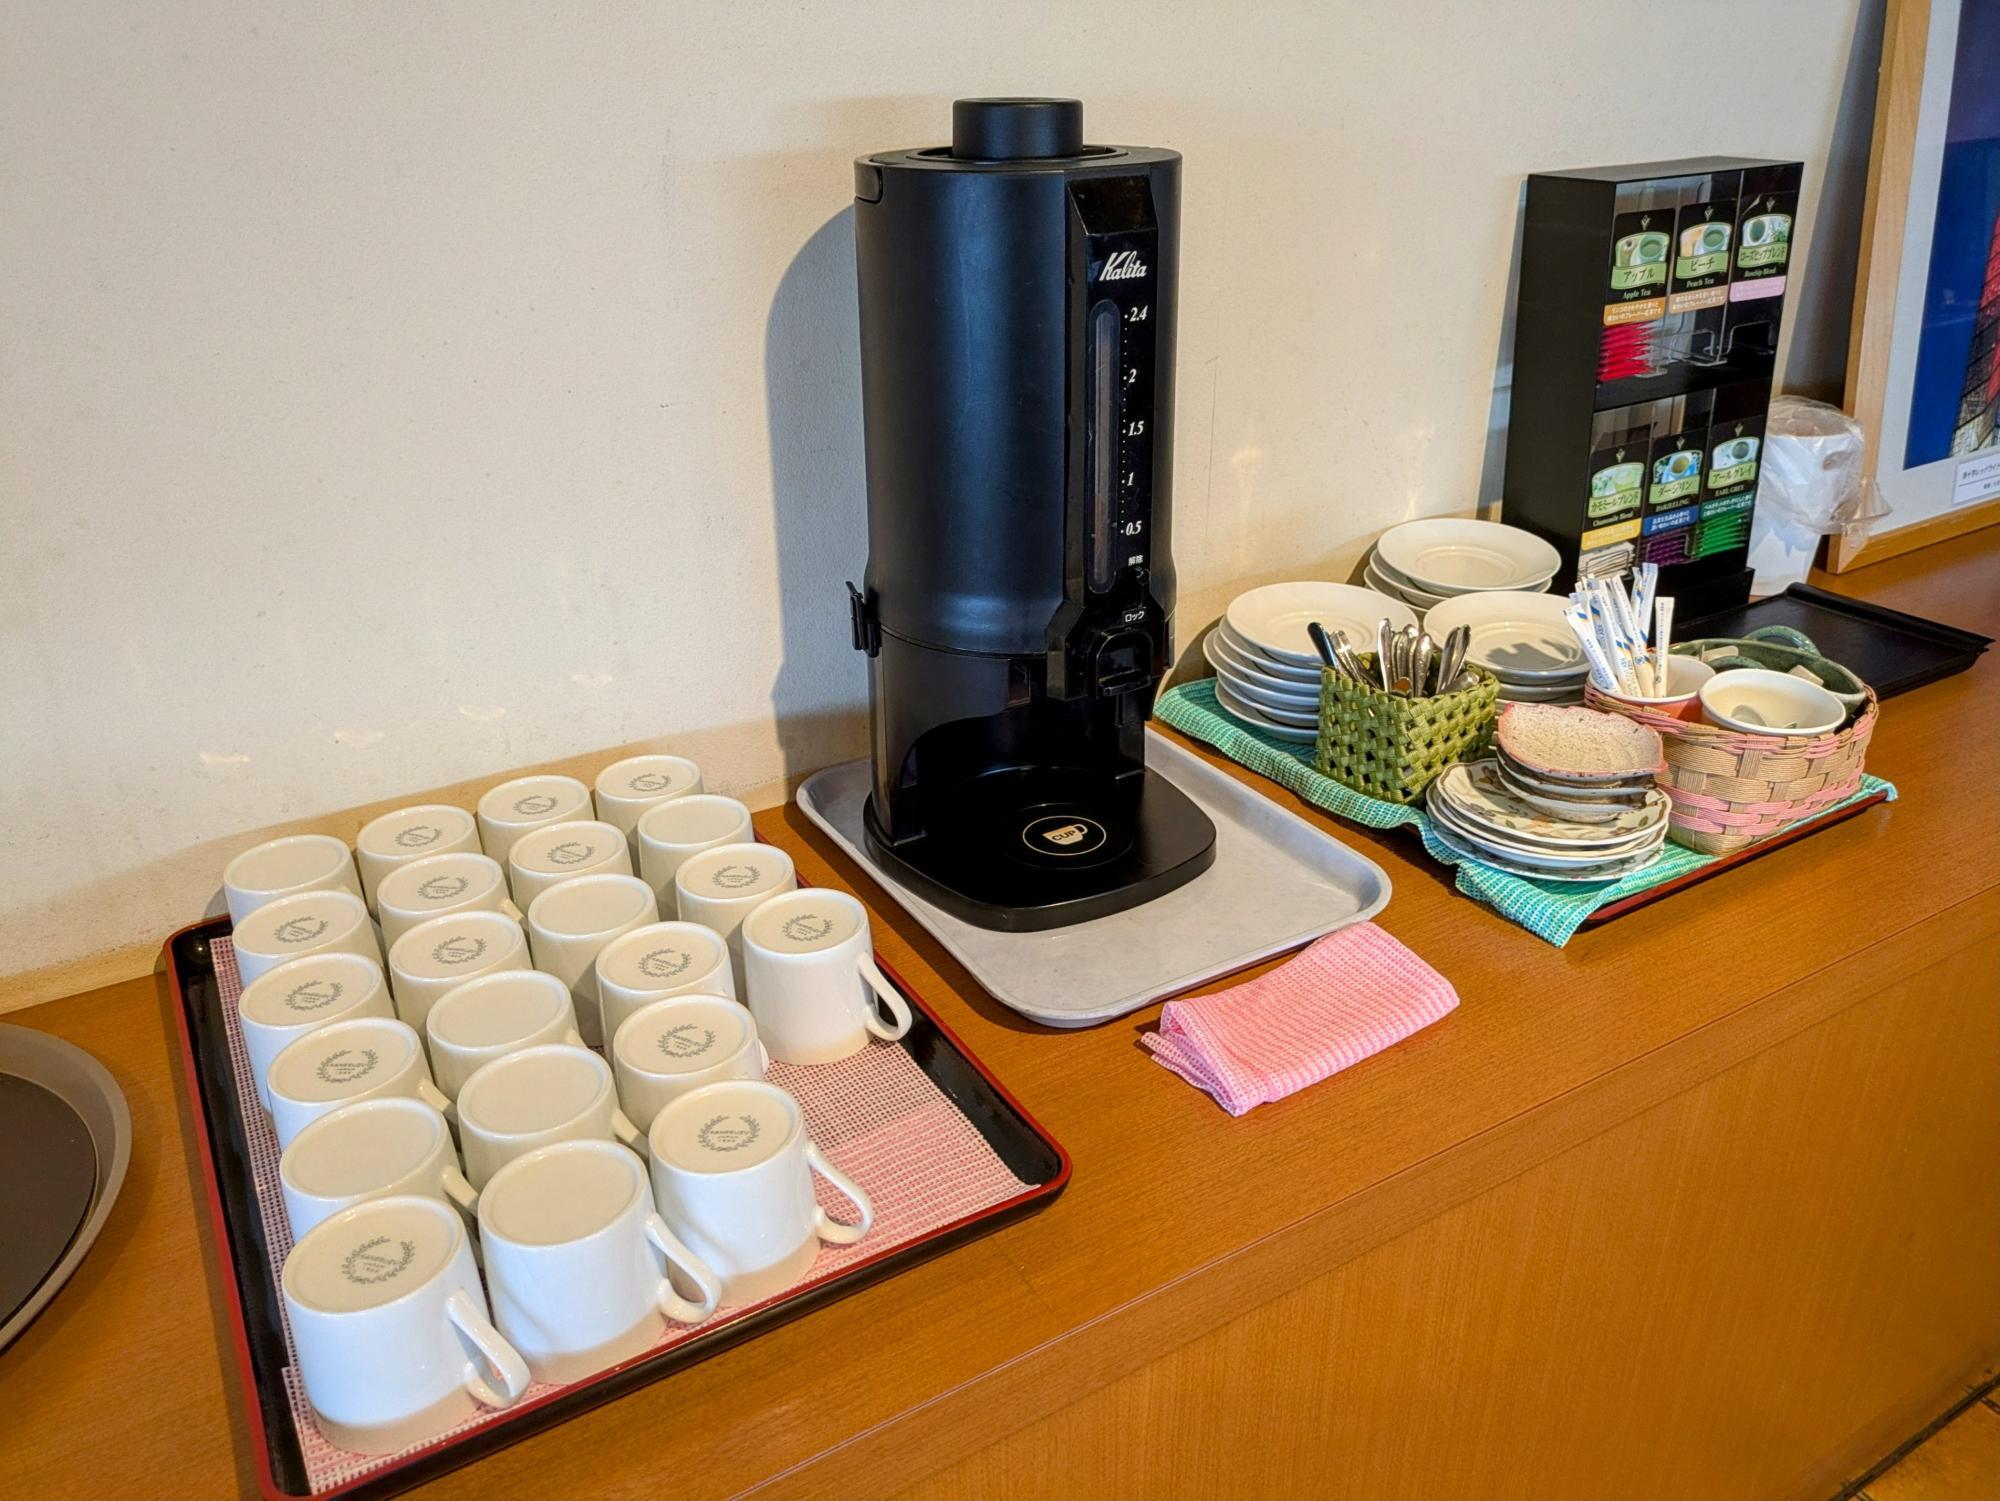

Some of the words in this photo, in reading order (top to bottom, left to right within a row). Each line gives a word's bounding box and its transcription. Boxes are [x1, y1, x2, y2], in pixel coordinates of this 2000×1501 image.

[1099, 250, 1147, 281] Kalita
[1690, 256, 1715, 271] ピーチ
[1623, 268, 1655, 283] アップル
[1704, 277, 1715, 285] Tea
[1622, 290, 1640, 300] Apple
[1640, 288, 1652, 297] Tea
[1129, 305, 1148, 322] 2.4
[1128, 368, 1137, 383] 2
[1128, 421, 1144, 437] 1.5
[1126, 472, 1134, 486] 1
[1712, 464, 1753, 484] アールグレイ
[1657, 480, 1693, 497] ダージリン
[1125, 521, 1142, 535] 0.5
[1125, 611, 1145, 622] ロック
[1051, 830, 1076, 841] CUP
